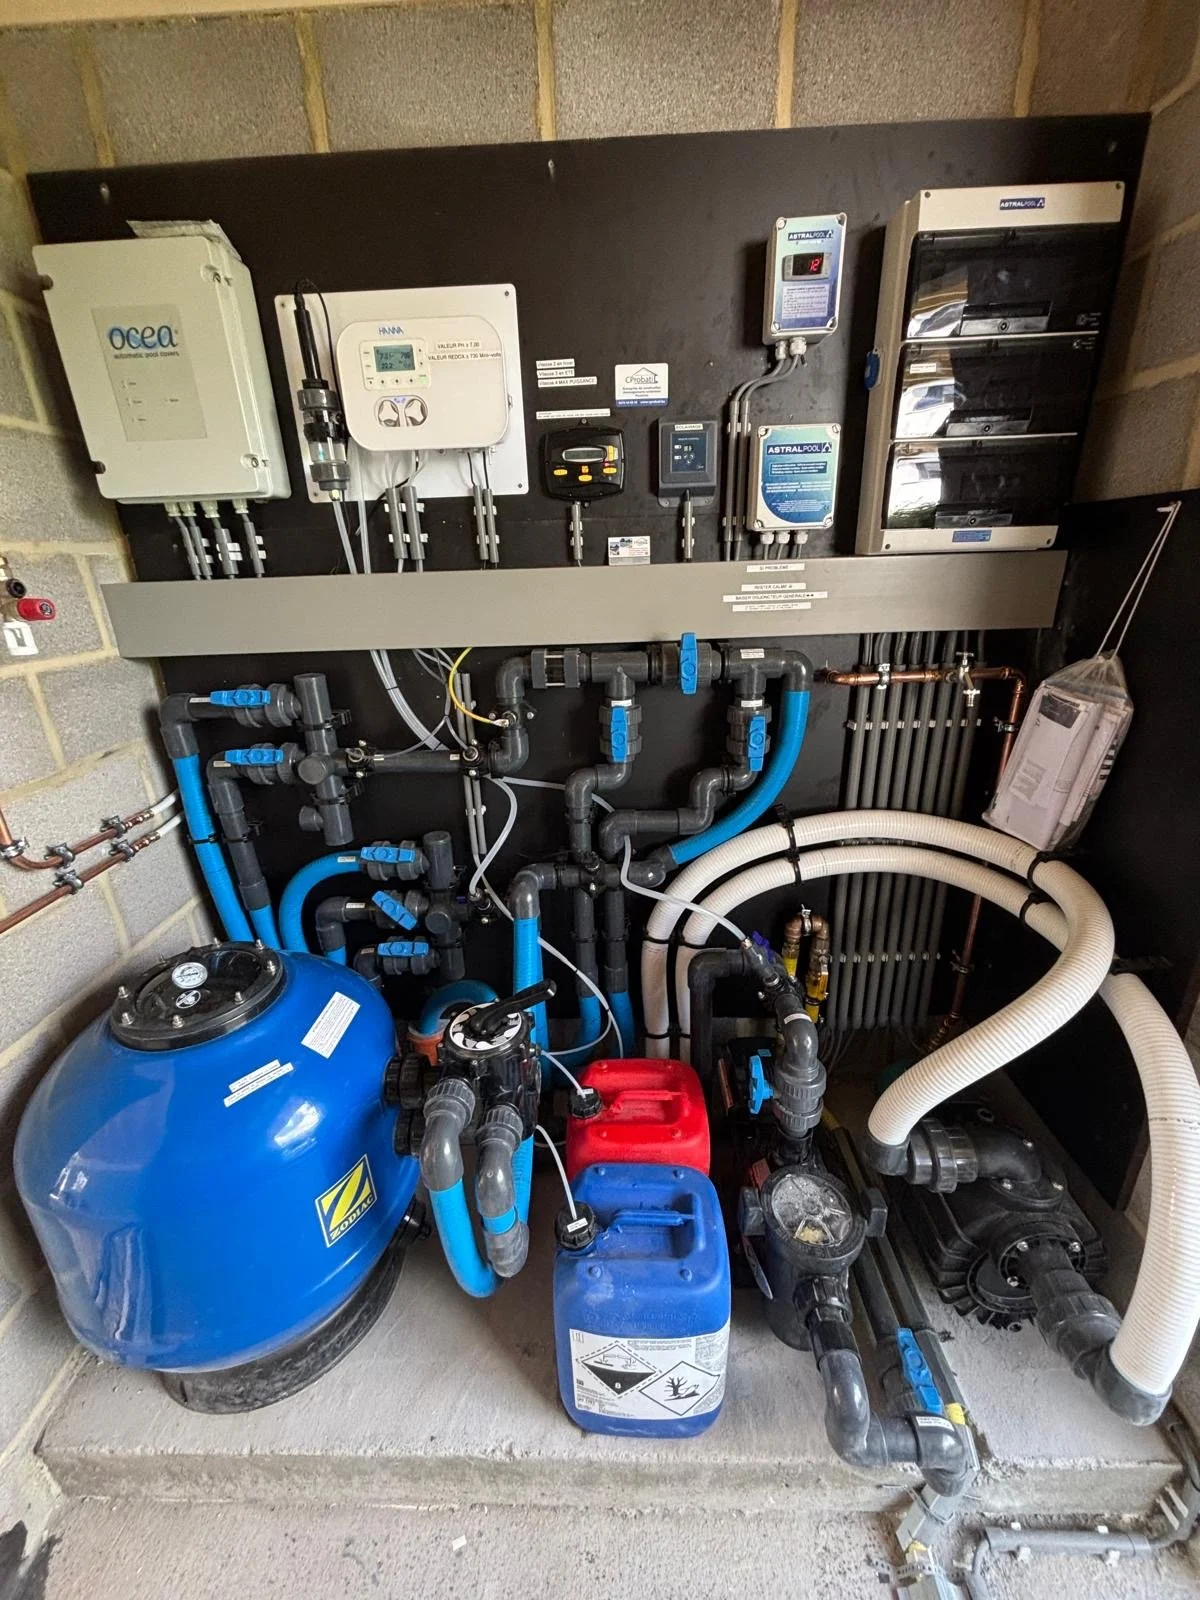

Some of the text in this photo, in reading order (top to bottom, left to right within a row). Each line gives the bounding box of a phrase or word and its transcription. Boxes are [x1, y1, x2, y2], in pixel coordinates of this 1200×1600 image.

[788, 231, 826, 240] ASTRALPOOL
[378, 326, 404, 336] HANNA
[109, 325, 178, 350] ocea
[768, 445, 821, 454] ASTRALPOOL
[330, 1194, 374, 1240] ZODIAC
